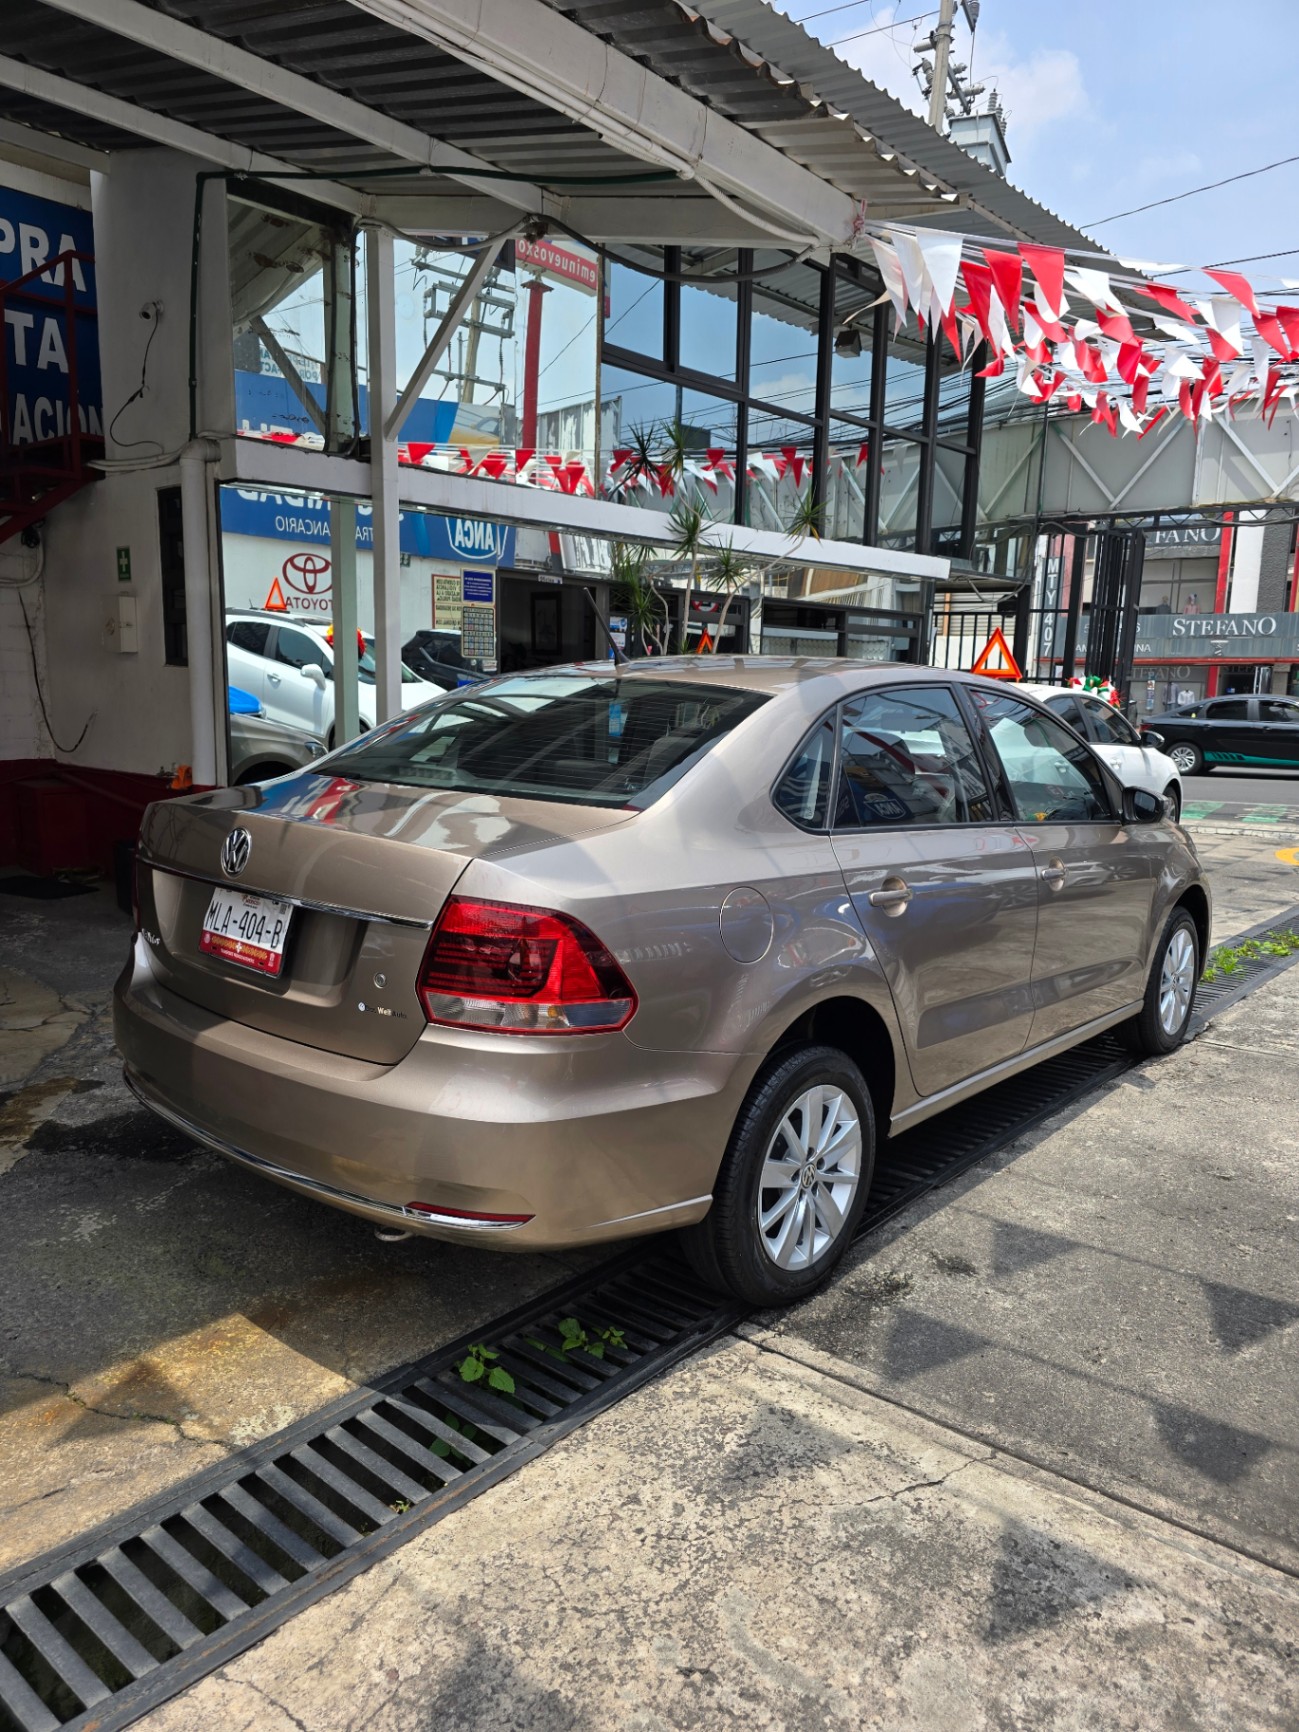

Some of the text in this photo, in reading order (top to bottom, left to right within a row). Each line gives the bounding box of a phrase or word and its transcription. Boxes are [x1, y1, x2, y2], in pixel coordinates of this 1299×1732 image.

[1155, 527, 1221, 544] FANO
[1172, 616, 1277, 636] STEFANO
[204, 900, 284, 949] MLA-404-B
